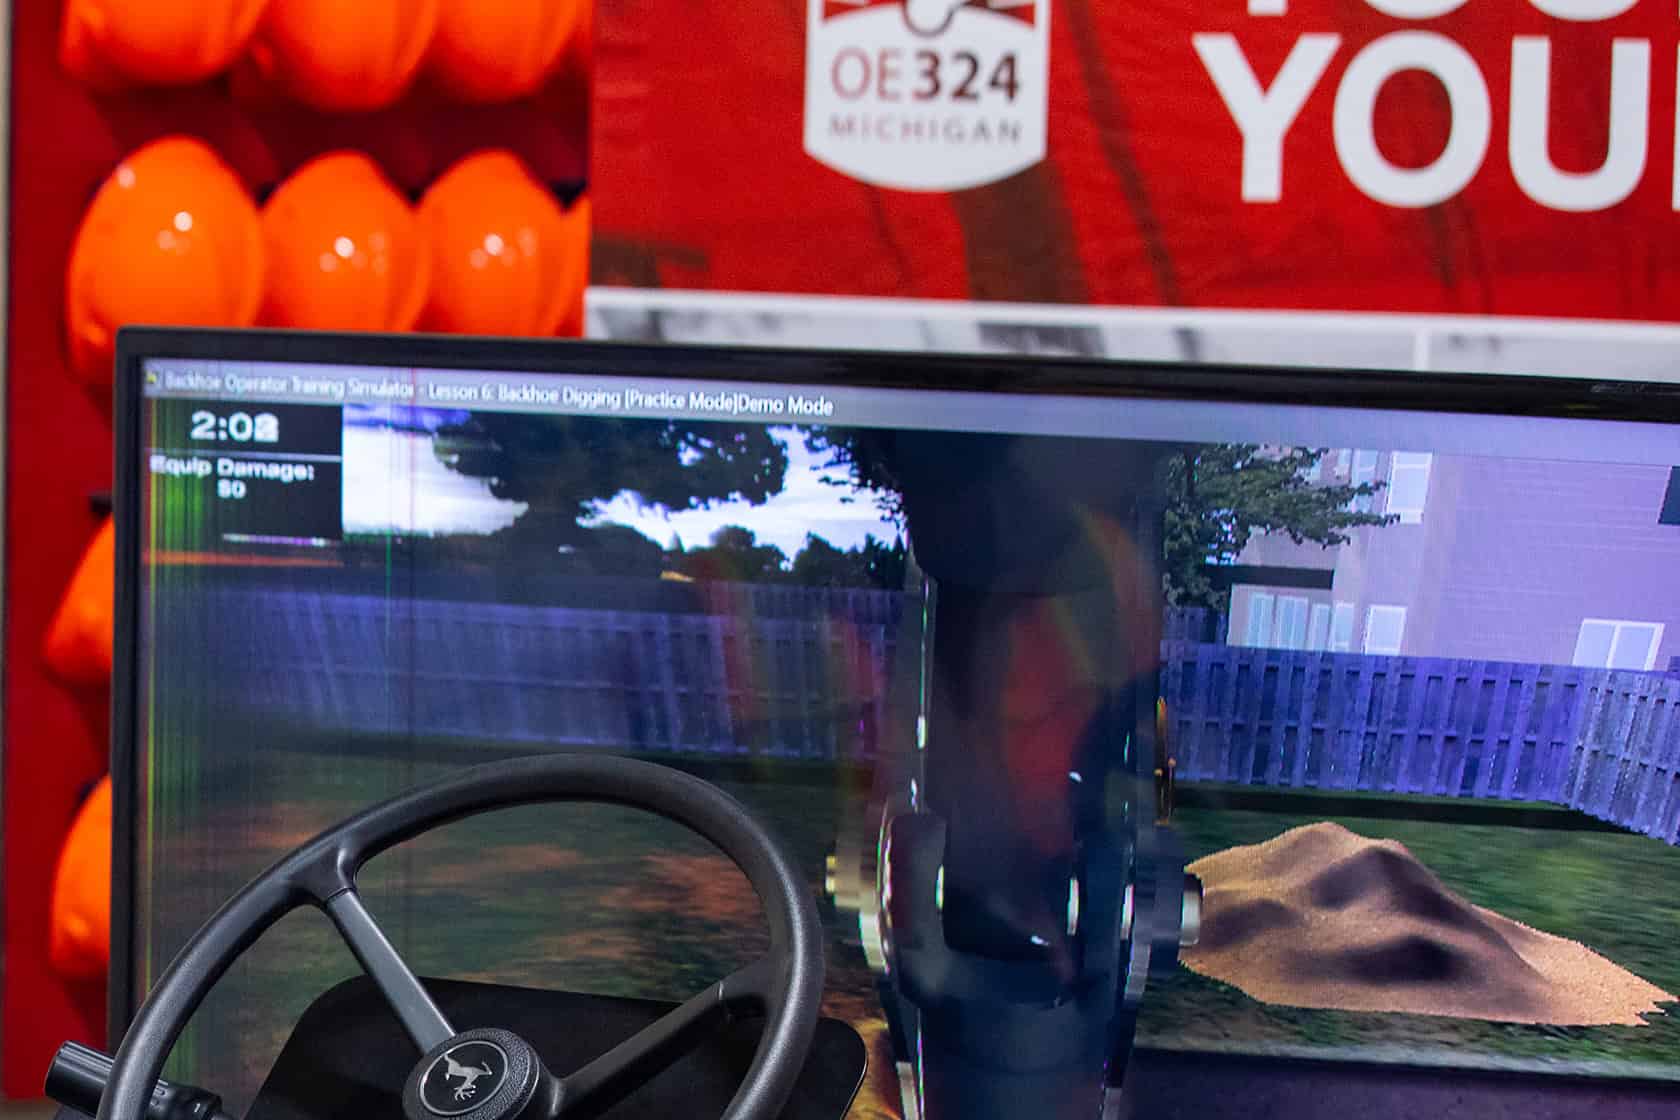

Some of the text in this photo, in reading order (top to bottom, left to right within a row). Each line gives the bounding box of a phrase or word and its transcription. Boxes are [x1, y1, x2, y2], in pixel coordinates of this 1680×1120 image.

[831, 47, 1020, 103] OE324
[828, 114, 1022, 142] MICHIGAN
[1191, 29, 1680, 213] YOU
[165, 371, 221, 391] Backhoe
[224, 373, 290, 395] Operator
[292, 375, 344, 399] Training
[347, 377, 415, 397] Simulator
[429, 383, 478, 401] Lesson
[498, 384, 560, 404] Backhoe
[563, 386, 621, 410] Digging
[787, 395, 834, 417] Mode
[149, 454, 315, 483] Equip Damage:
